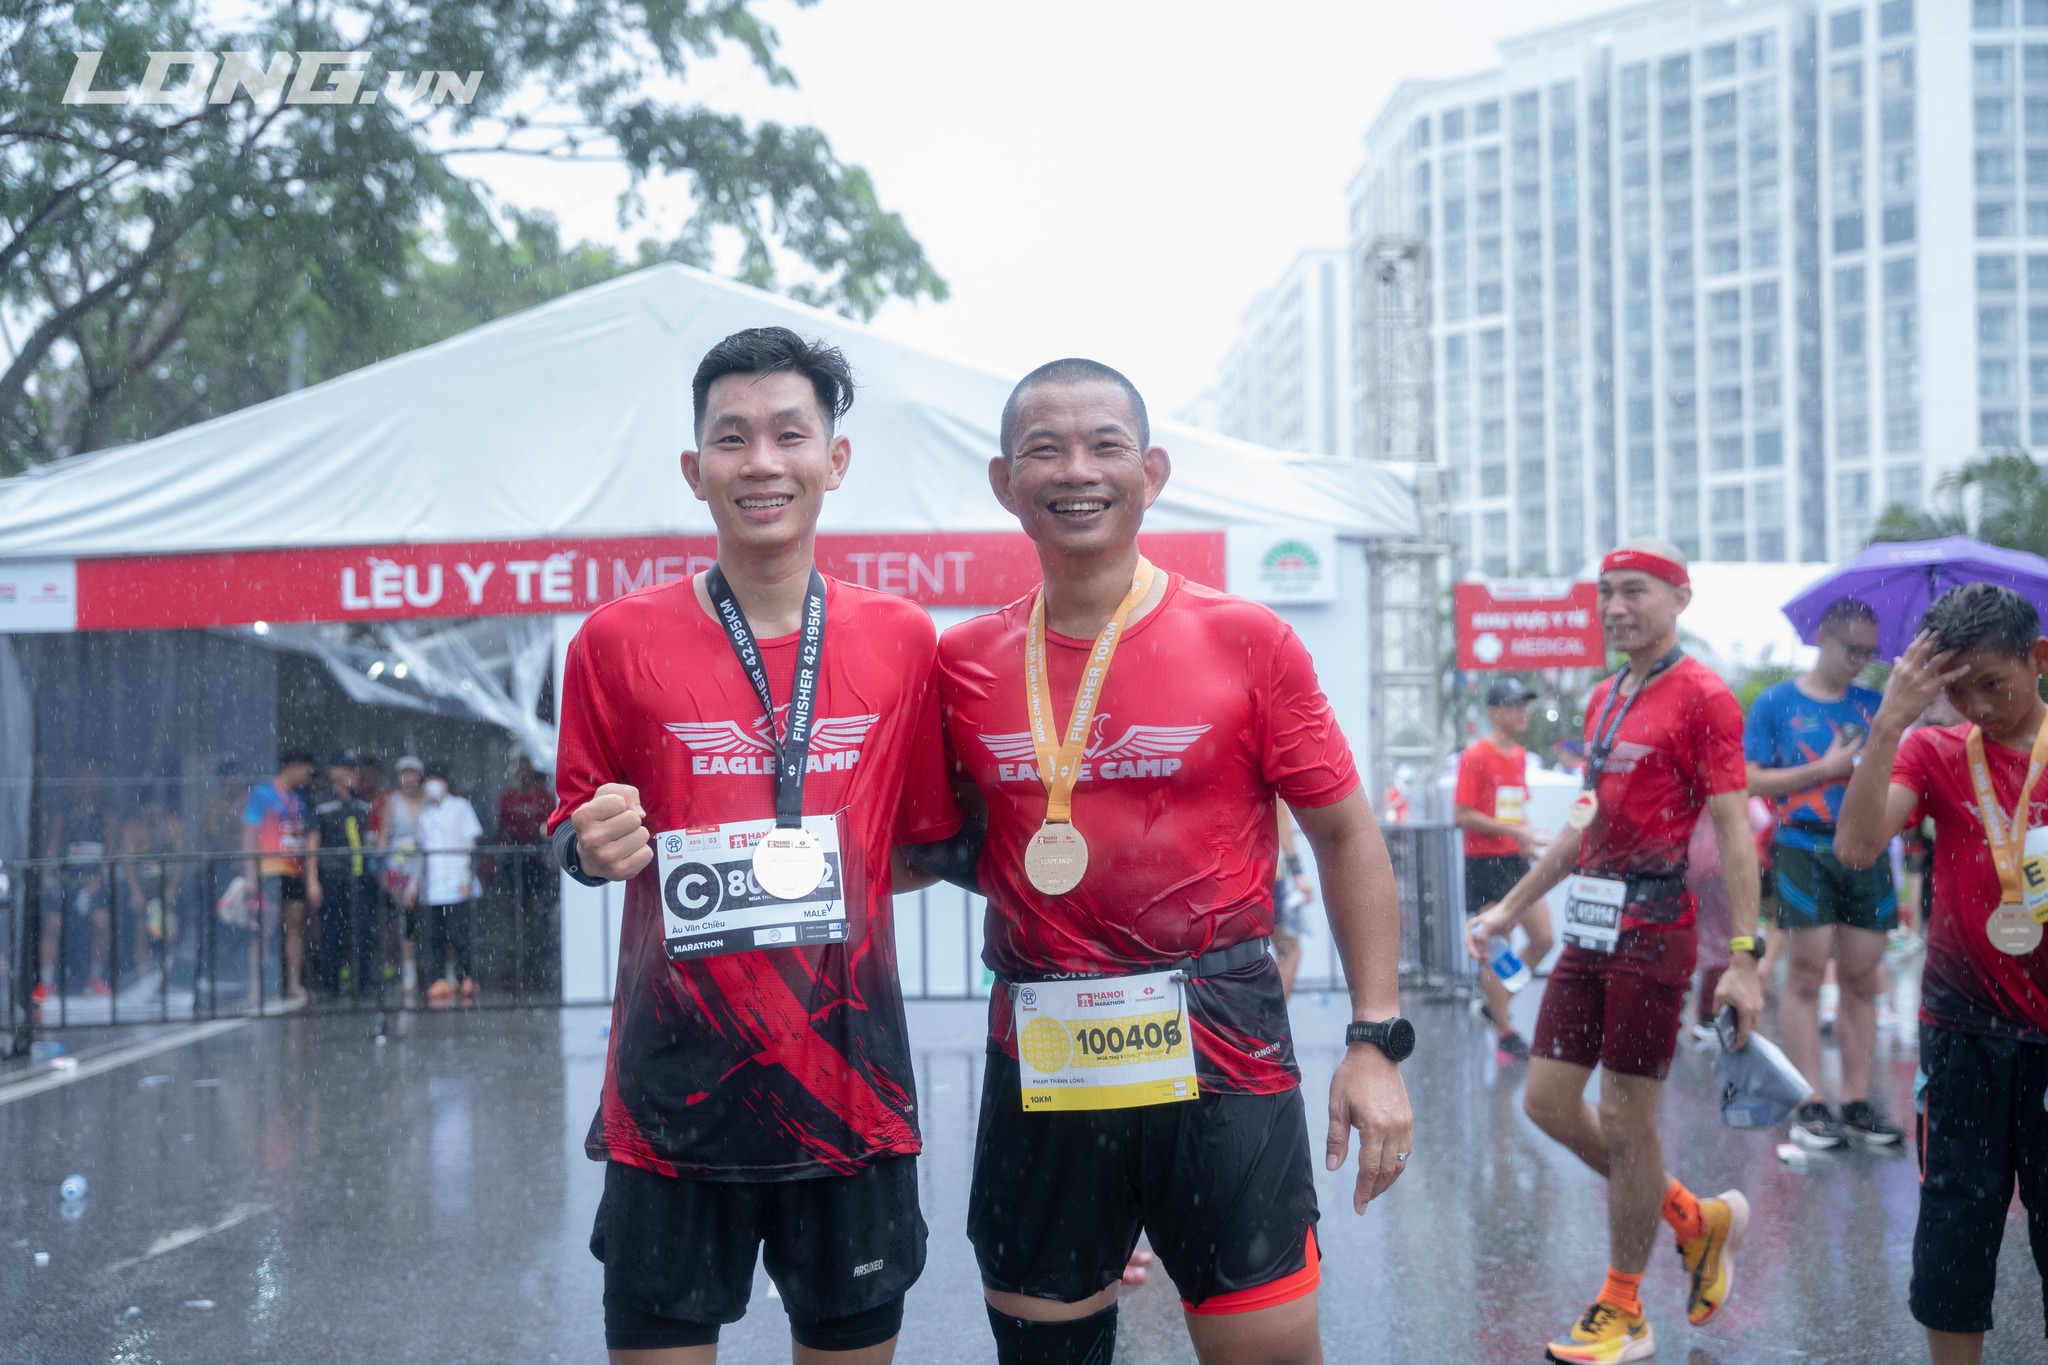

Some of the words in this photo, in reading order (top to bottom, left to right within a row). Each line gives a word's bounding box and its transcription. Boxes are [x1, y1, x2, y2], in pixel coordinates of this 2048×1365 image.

[341, 555, 443, 610] LỀU
[455, 561, 495, 605] Y
[505, 550, 579, 603] TẾ
[846, 551, 976, 597] TENT
[719, 598, 756, 666] 42.195KM
[792, 668, 814, 742] FINISHER
[803, 595, 821, 666] 42.195KM
[1070, 667, 1101, 742] FINISHER
[1095, 621, 1118, 662] 10KM
[692, 755, 776, 775] EAGLE
[806, 750, 860, 774] AMP
[1100, 758, 1182, 779] CAMP
[2023, 860, 2046, 888] E
[677, 873, 710, 910] C
[803, 910, 827, 918] MALE
[673, 939, 724, 953] MARATHON
[1093, 990, 1124, 1000] HANOI
[1076, 1020, 1182, 1055] 100406
[853, 1258, 884, 1277] ARSUXEO
